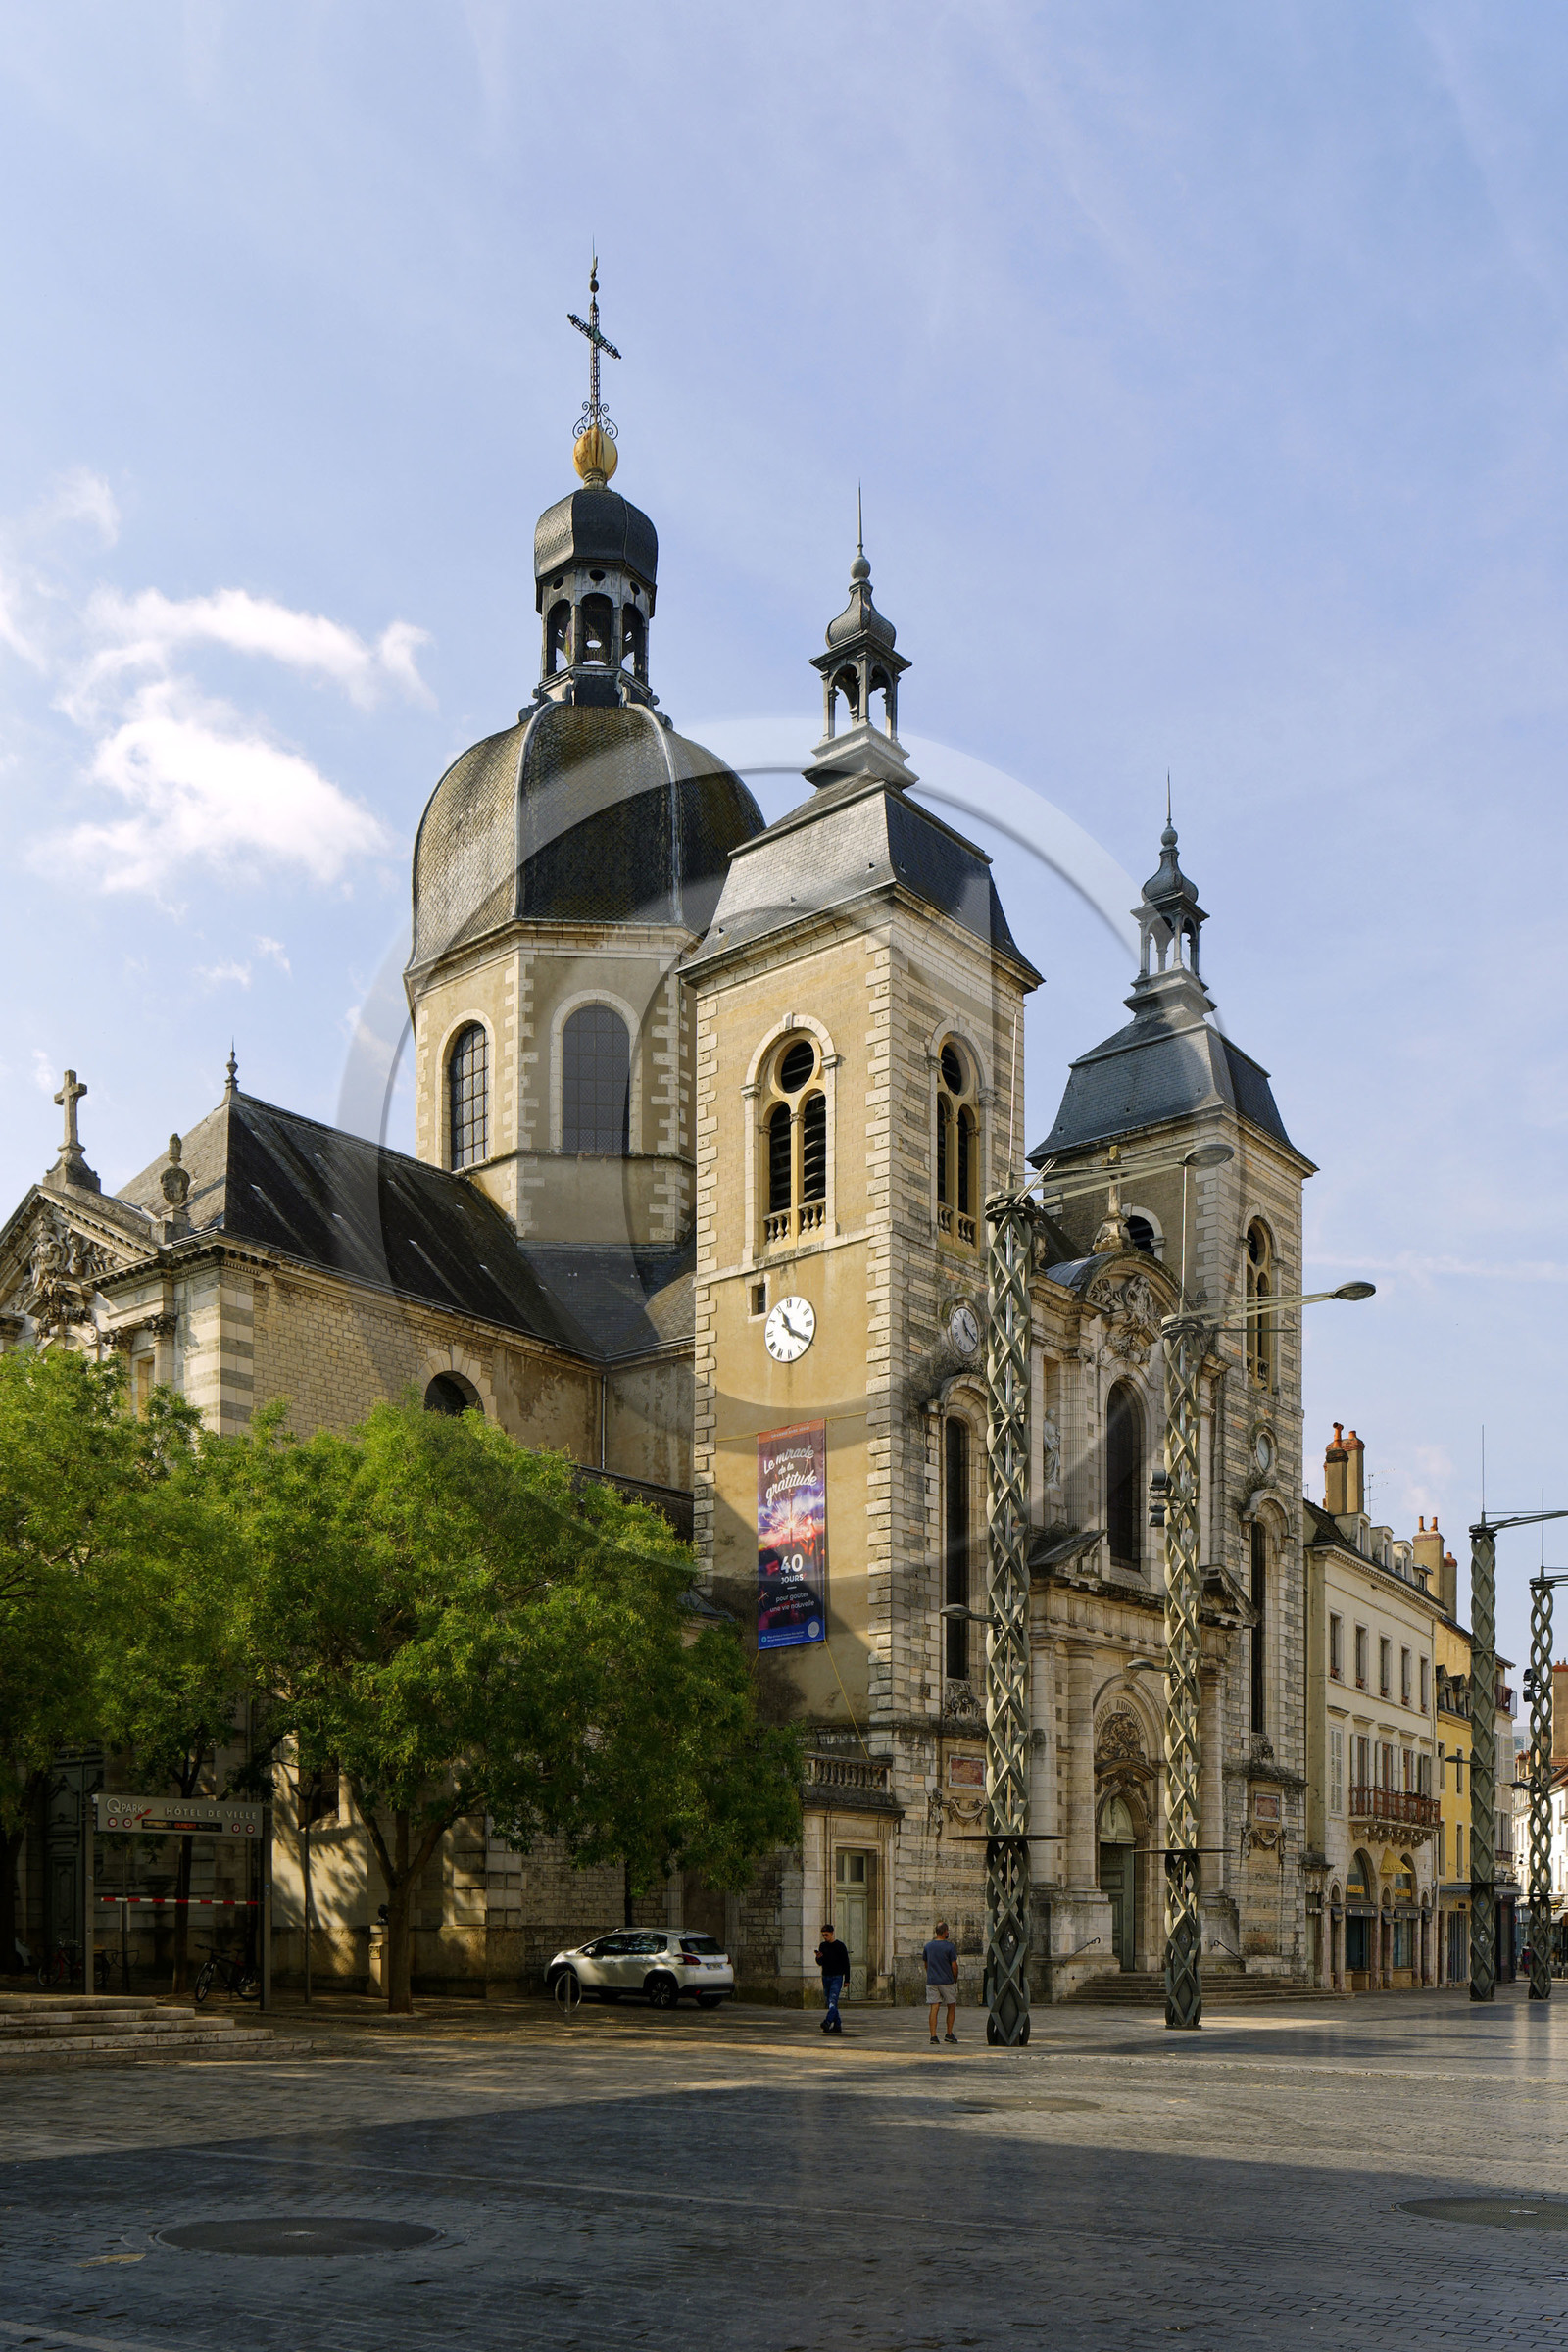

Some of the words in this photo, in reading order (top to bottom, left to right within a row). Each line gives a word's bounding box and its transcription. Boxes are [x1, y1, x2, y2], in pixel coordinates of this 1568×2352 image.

[763, 1459, 775, 1474] Le
[775, 1445, 814, 1465] miracle
[778, 1464, 787, 1475] de
[787, 1462, 795, 1471] la
[765, 1470, 817, 1507] gratitude
[780, 1553, 803, 1573] 40
[780, 1574, 804, 1584] JOURS
[166, 1805, 202, 1817] HÔTEL
[207, 1809, 220, 1818] DE
[226, 1810, 257, 1820] VILLE
